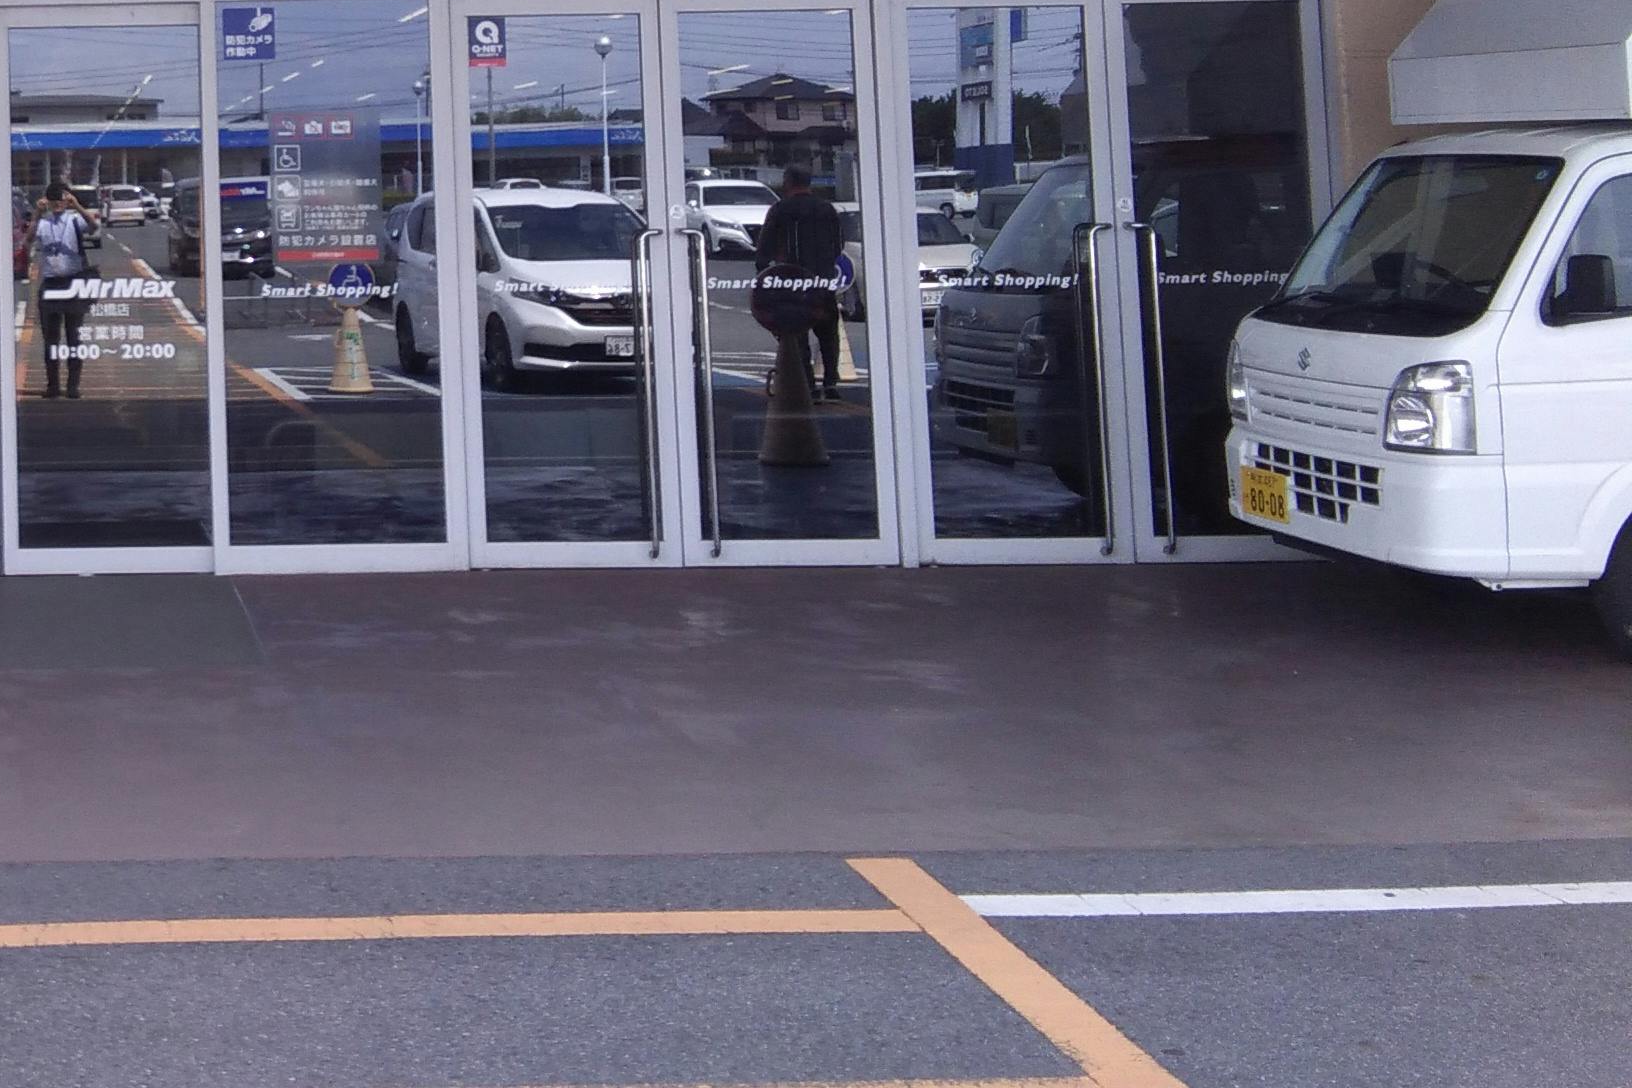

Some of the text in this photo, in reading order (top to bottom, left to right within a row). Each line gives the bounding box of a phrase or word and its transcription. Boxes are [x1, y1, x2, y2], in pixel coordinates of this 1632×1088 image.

[225, 34, 273, 45] 防犯カメラ
[226, 46, 257, 57] 作動中
[278, 234, 377, 246] 防犯カメラ設置店
[707, 275, 847, 291] Smart Shopping!
[938, 273, 1079, 289] Smart Shopping!
[1159, 272, 1207, 284] Smart
[43, 278, 176, 300] MrMax
[261, 282, 399, 298] Smart Shopping!
[494, 280, 544, 292] Smart
[78, 325, 145, 340] 営業時間
[1250, 487, 1285, 518] 80-08
